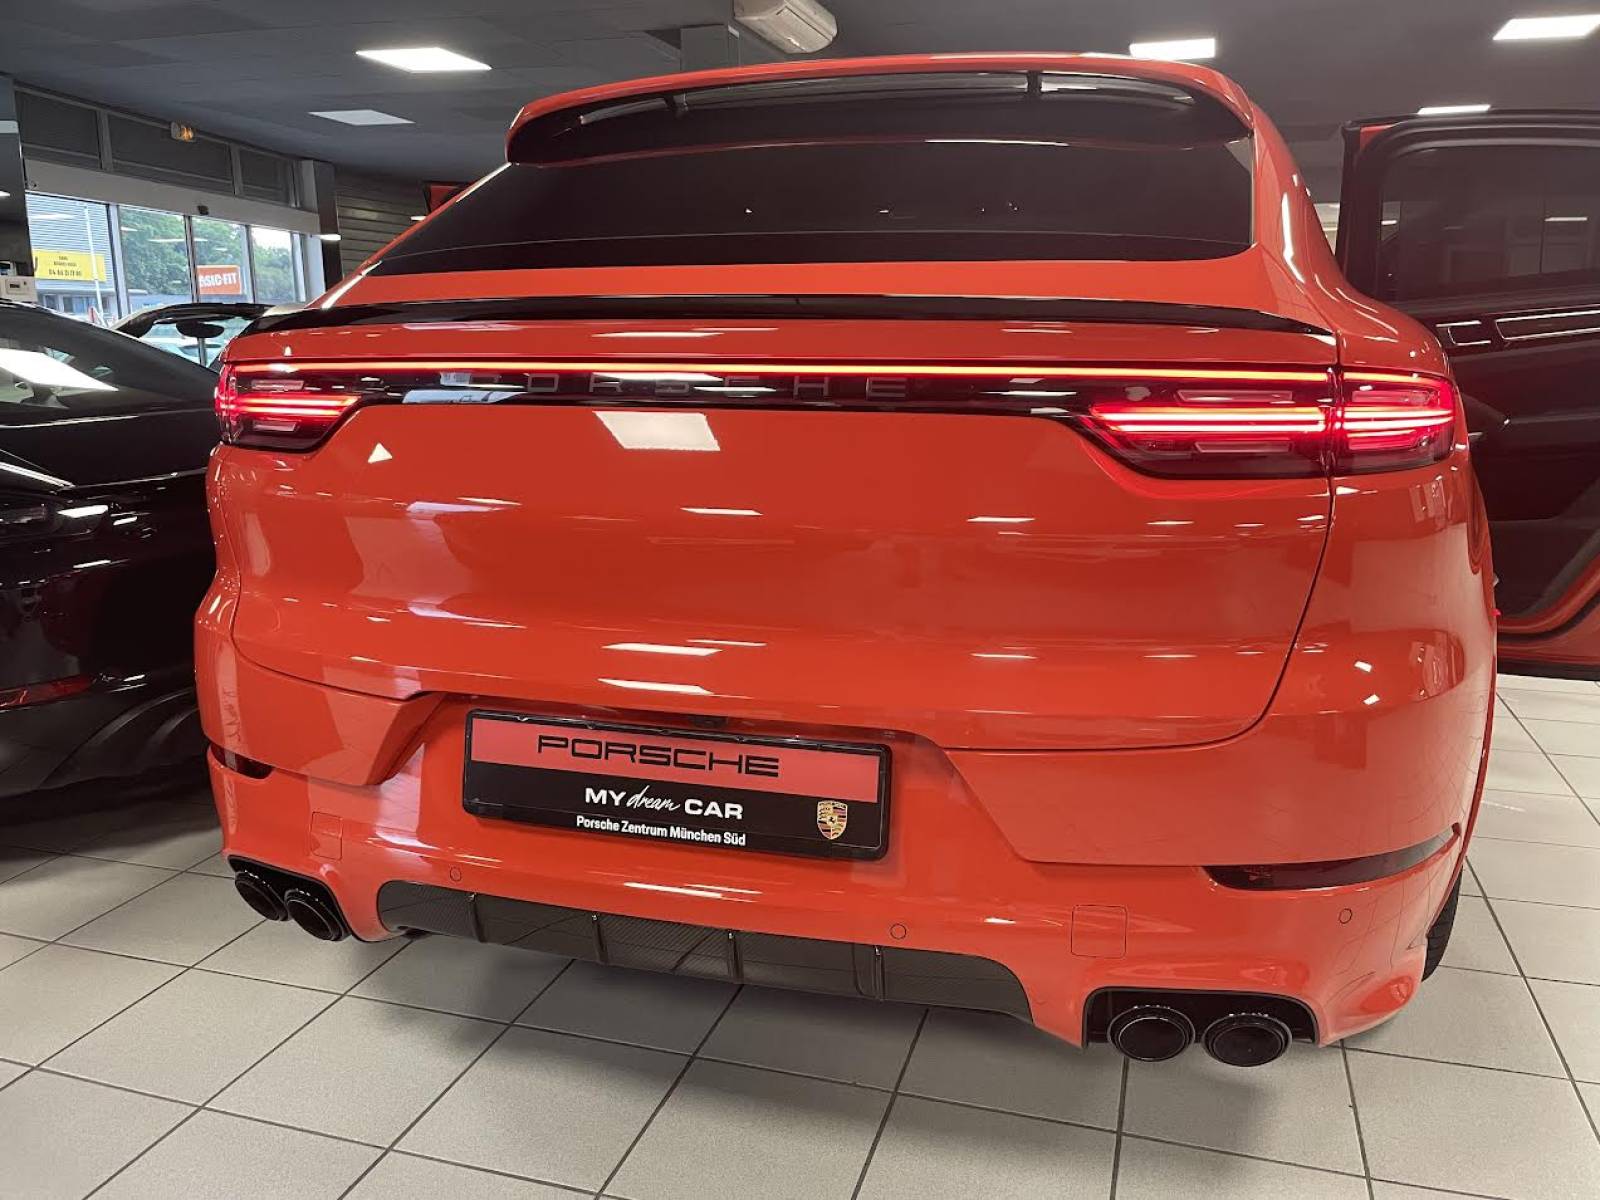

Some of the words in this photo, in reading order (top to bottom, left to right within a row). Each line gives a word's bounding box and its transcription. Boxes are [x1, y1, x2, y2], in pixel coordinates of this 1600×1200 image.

[537, 734, 780, 778] PORSCHE
[585, 787, 627, 806] MY
[626, 785, 681, 811] dream
[684, 799, 744, 820] CAR
[576, 815, 620, 832] Porsche
[621, 820, 668, 838] Zentrum
[669, 826, 722, 843] München
[723, 832, 746, 846] Süd
